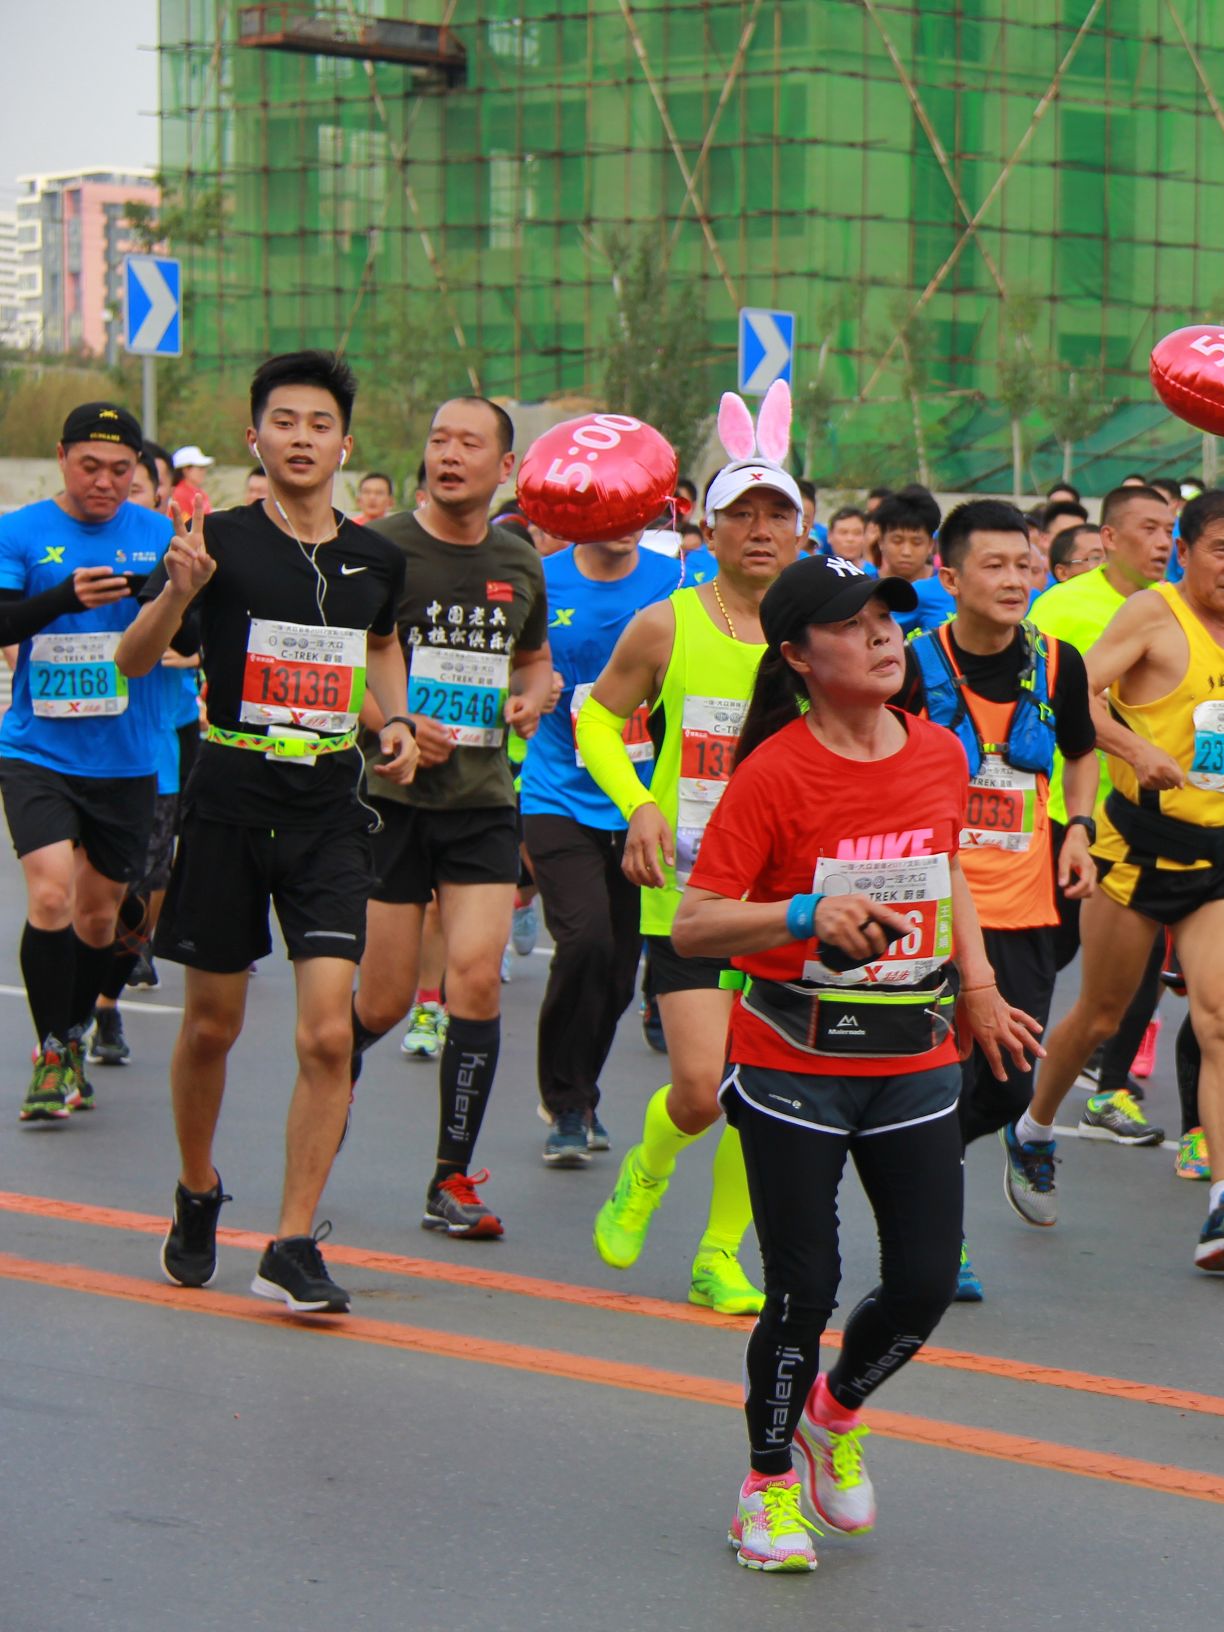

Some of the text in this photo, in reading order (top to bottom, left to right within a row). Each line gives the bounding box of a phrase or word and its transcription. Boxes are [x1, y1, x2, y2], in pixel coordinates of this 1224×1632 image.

[544, 414, 642, 494] 5:00
[426, 600, 507, 626] 中国老兵
[281, 649, 320, 662] C-TREK
[37, 667, 109, 697] 22168
[261, 666, 341, 708] 13136
[414, 686, 496, 725] 22546
[836, 828, 934, 861] NIKE
